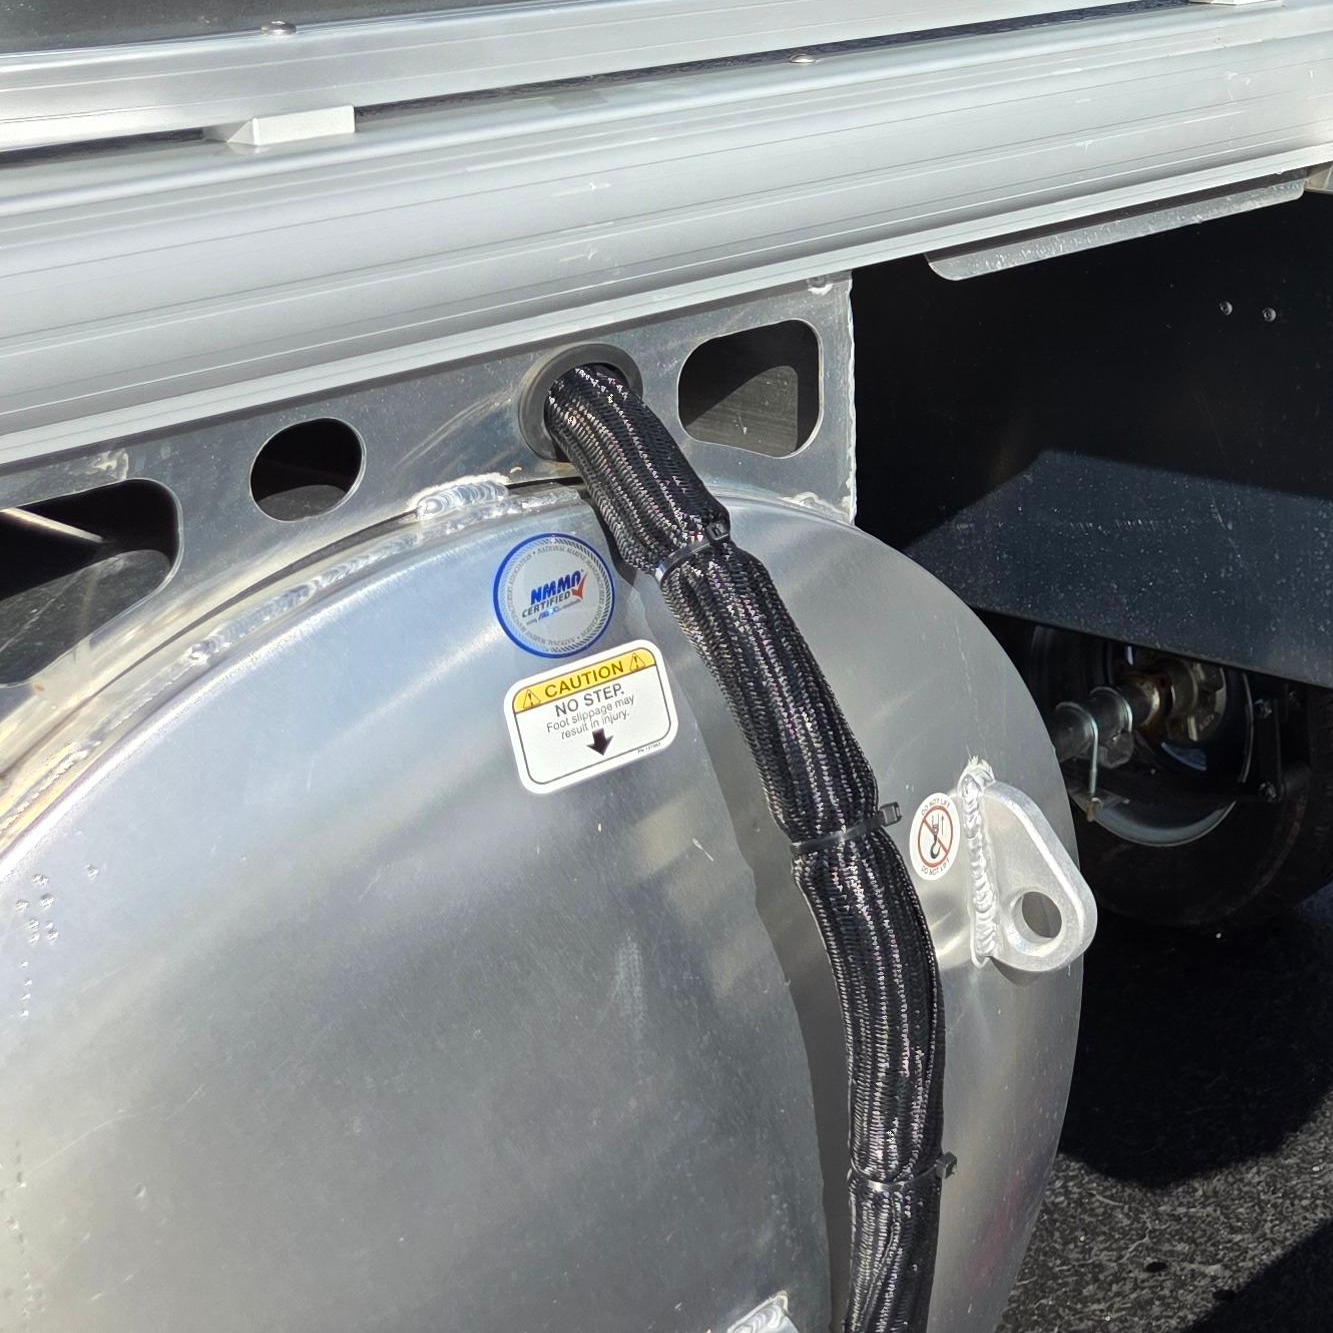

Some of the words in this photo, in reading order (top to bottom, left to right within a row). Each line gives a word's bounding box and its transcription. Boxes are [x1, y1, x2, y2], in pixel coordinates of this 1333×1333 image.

[522, 590, 571, 618] CERTIFIED
[544, 660, 624, 698] CAUTION
[547, 717, 571, 733] Foot
[571, 704, 614, 727] slippage
[615, 694, 635, 712] may
[555, 699, 579, 717] NO
[584, 683, 625, 709] STEP.
[561, 723, 589, 740] result
[590, 719, 600, 731] in
[602, 710, 630, 729] injury.
